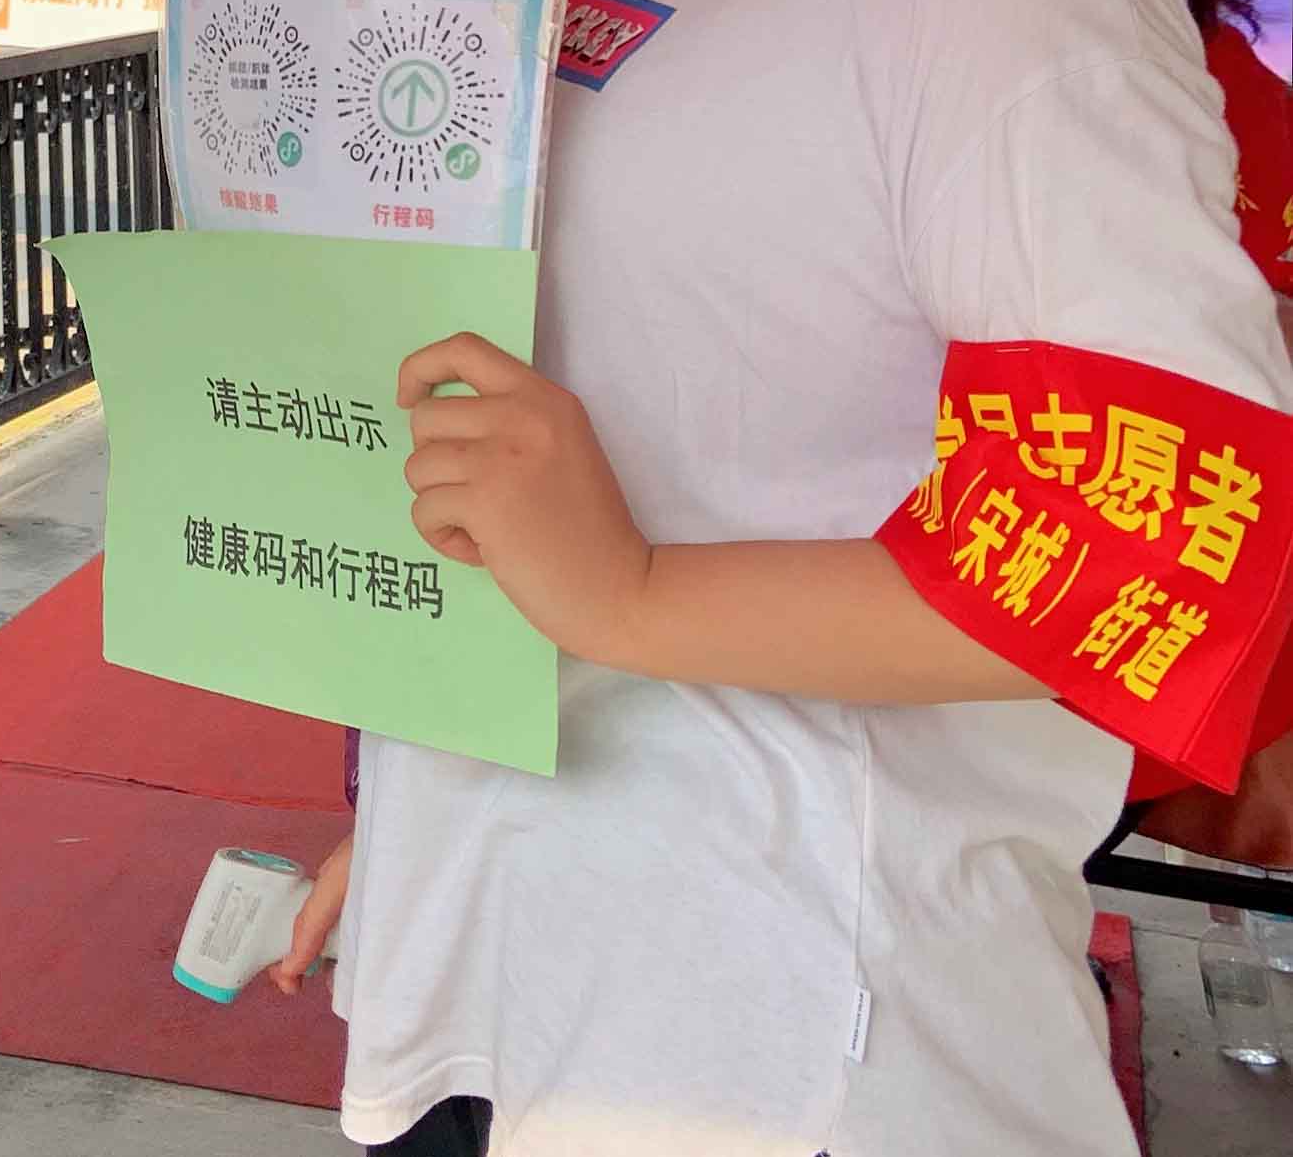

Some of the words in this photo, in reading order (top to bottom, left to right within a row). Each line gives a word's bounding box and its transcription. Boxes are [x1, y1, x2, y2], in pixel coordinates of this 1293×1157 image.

[372, 202, 435, 230] 行程码
[205, 376, 388, 451] 请主动出示
[182, 513, 444, 620] 健康码和行程码
[1072, 574, 1210, 702] 街道
